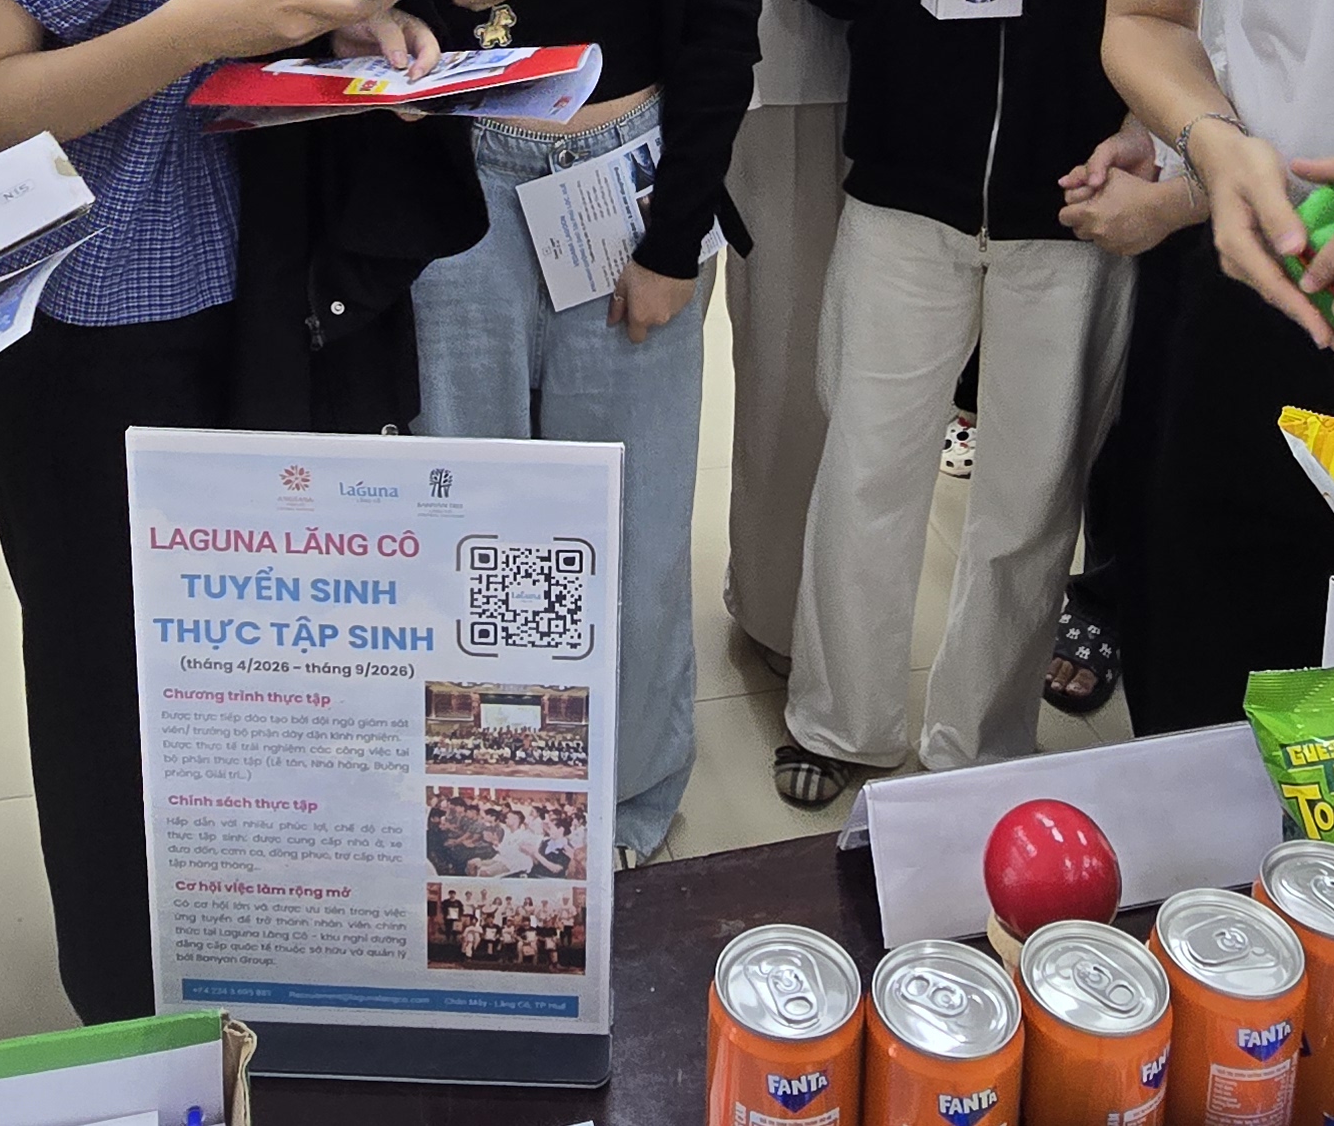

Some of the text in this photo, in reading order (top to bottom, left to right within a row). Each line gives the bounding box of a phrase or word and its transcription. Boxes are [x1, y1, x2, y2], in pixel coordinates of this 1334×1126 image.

[150, 527, 420, 558] LAGUNA LĂNG CÔ
[180, 566, 397, 606] TUYỂN SINH
[153, 616, 435, 655] THỰC TẬP SINH
[180, 658, 232, 675] (tháng
[237, 660, 289, 673] 4/2026
[305, 662, 351, 679] tháng
[355, 663, 414, 680] 9/2026)
[163, 687, 224, 704] Chương
[267, 692, 302, 707] thực
[306, 693, 330, 709] tập
[168, 794, 317, 814] Chính sách thực tập
[175, 880, 351, 900] Cơ hội việc làm rộng mở
[1238, 1021, 1291, 1048] FANTA
[767, 1071, 828, 1096] FANTA
[939, 1089, 998, 1115] FANTA
